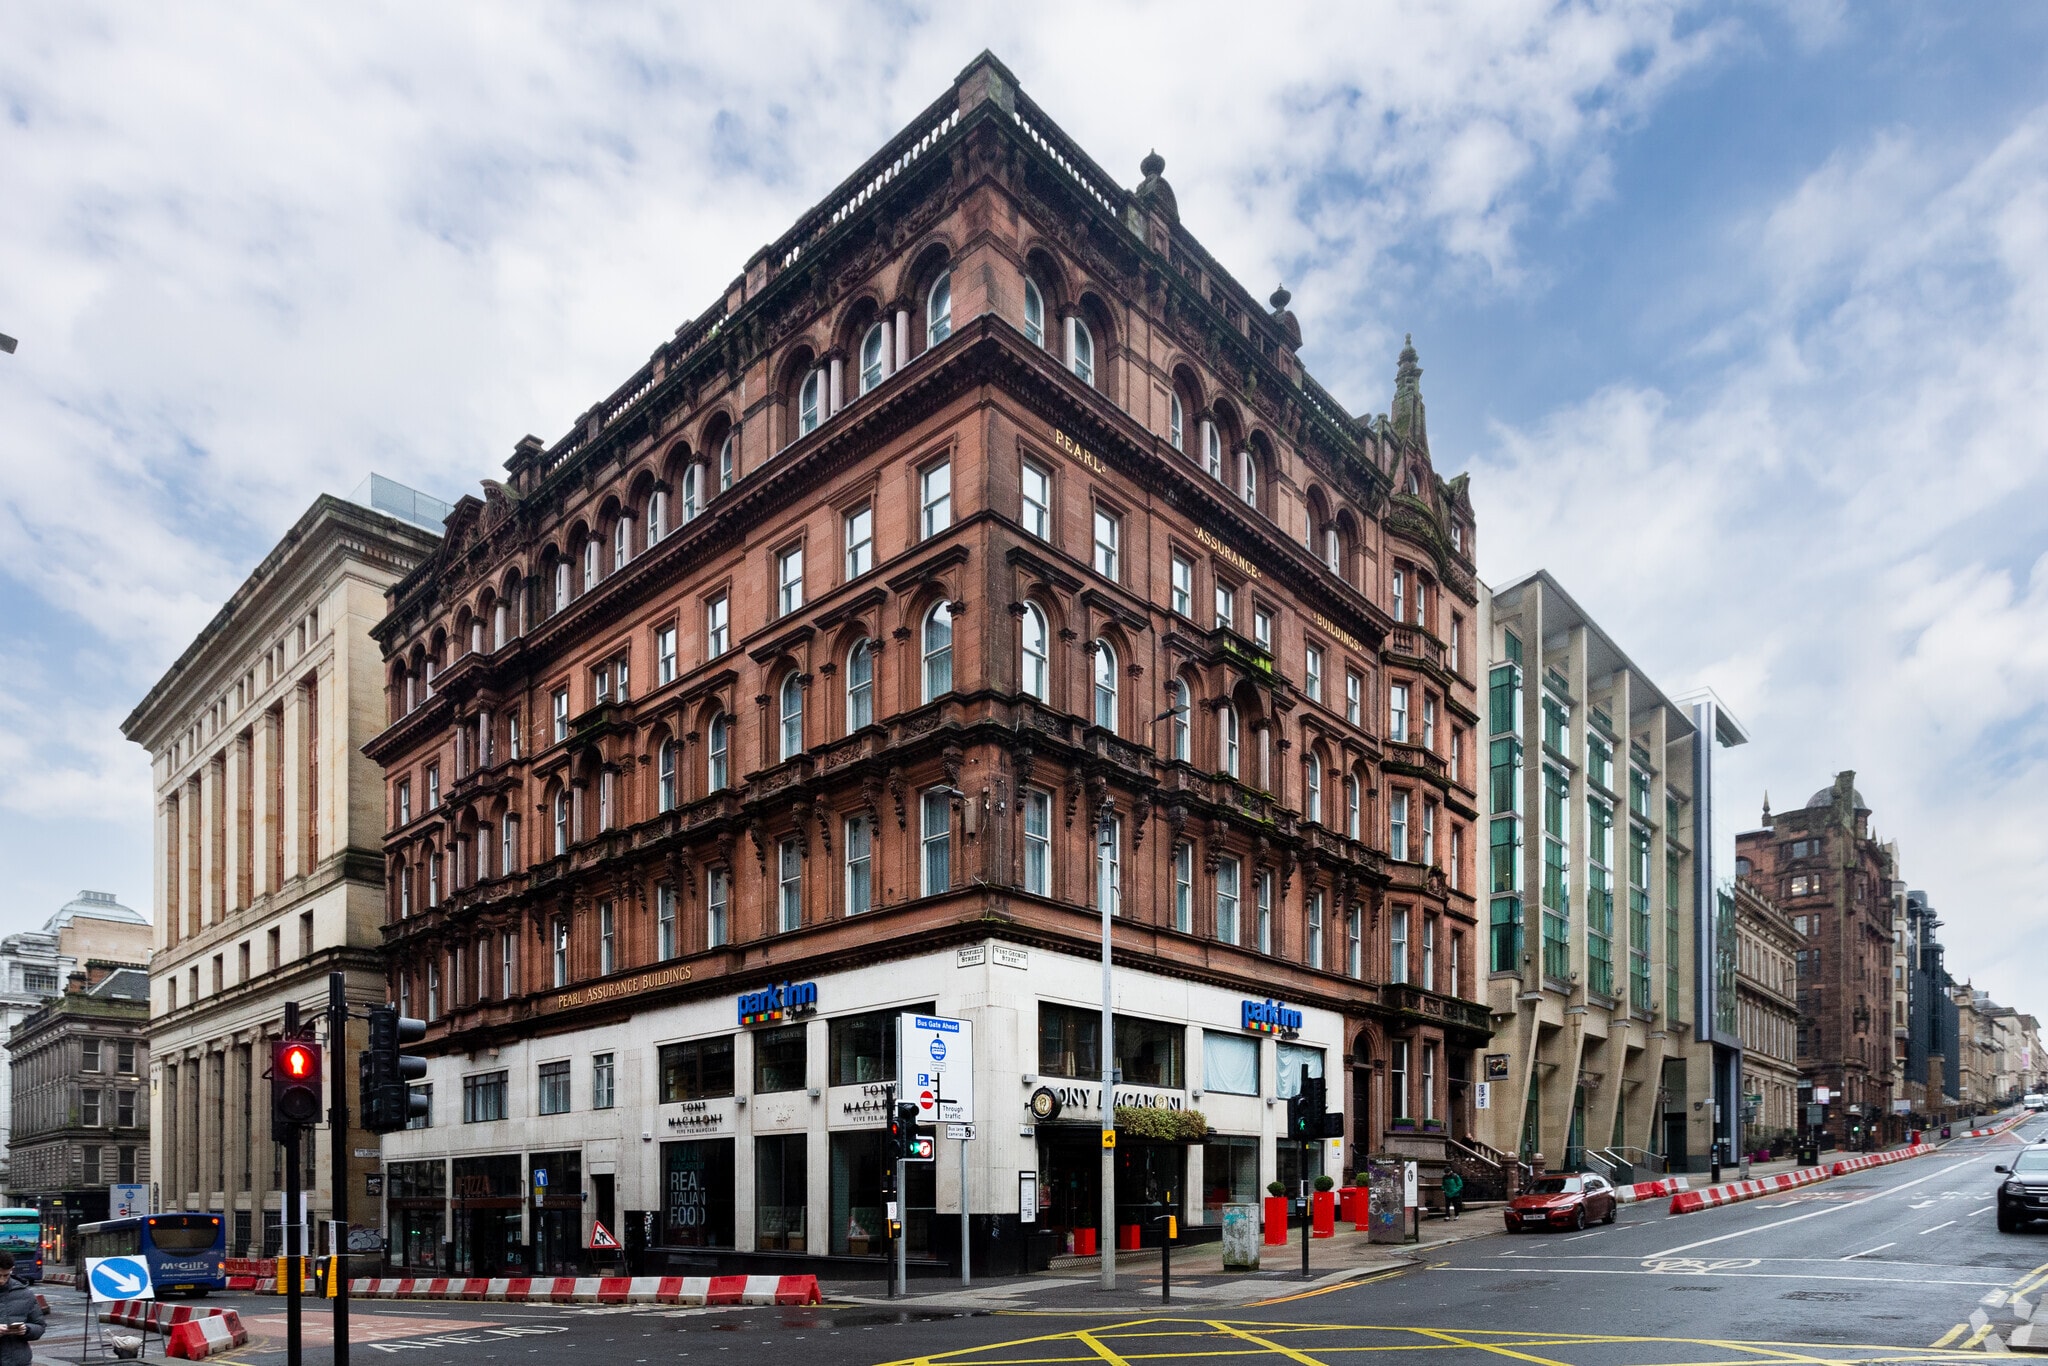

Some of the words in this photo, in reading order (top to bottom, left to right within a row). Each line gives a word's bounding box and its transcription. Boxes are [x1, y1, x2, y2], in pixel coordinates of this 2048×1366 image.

[1055, 428, 1102, 474] PEARL
[1197, 526, 1258, 579] ASSURANCE
[1316, 612, 1359, 652] BUILDINGS
[958, 948, 984, 958] RENFIELD
[961, 954, 982, 963] STREET
[558, 992, 583, 1008] PEARL
[586, 977, 639, 1003] ASSURANCE
[642, 965, 692, 990] BUILDINGS
[738, 983, 782, 1025] park
[783, 980, 818, 1008] inn
[1242, 998, 1279, 1028] park
[1278, 1001, 1303, 1029] inn
[916, 1018, 928, 1027] Bus
[928, 1021, 941, 1029] Gate
[942, 1022, 958, 1031] Ahead
[1055, 1086, 1091, 1108] ONY
[942, 1105, 964, 1113] Through
[668, 1113, 722, 1127] MACARONI
[670, 1191, 706, 1206] ITALIAN
[160, 1261, 209, 1270] McGill's
[367, 1325, 570, 1353] AHEAD
